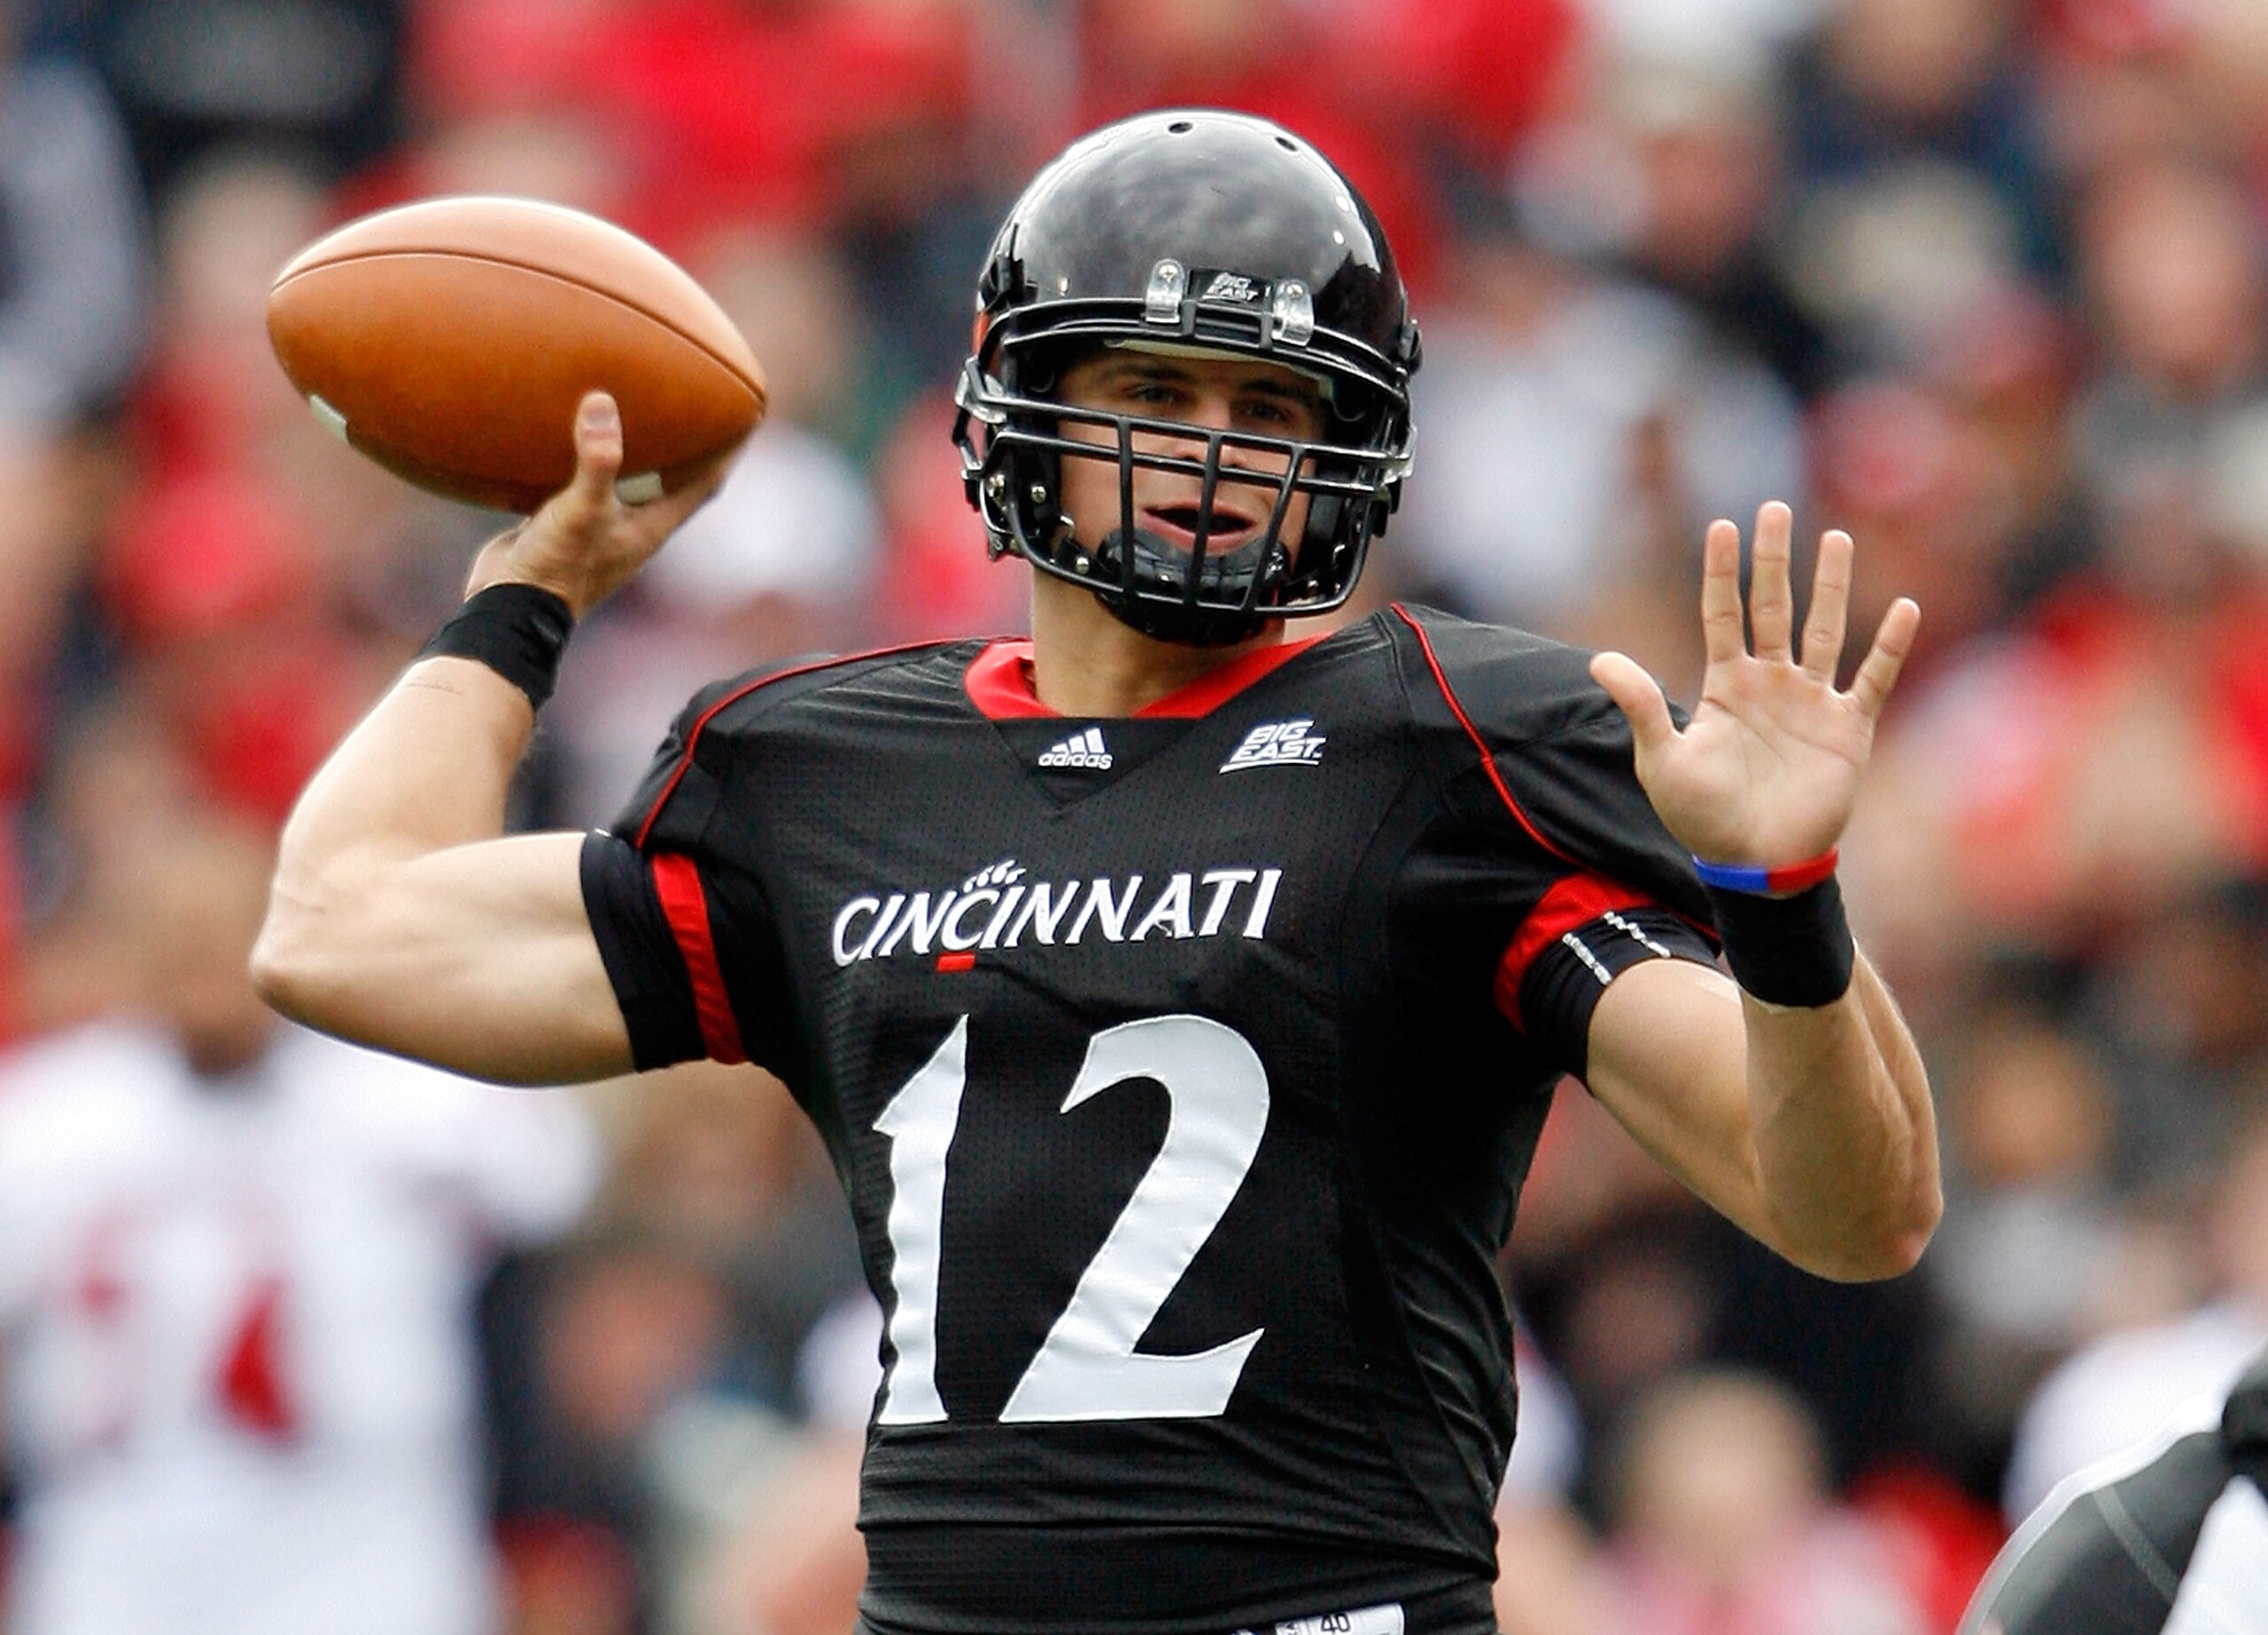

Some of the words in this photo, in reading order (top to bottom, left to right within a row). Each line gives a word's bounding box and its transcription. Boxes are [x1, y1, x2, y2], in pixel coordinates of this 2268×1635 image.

[1244, 720, 1314, 745] BIG
[1038, 751, 1114, 770] adidas
[1230, 738, 1326, 761] EAST
[832, 864, 1283, 966] CINCINNATI
[873, 1014, 1270, 1425] 12
[1320, 1613, 1350, 1633] 40
